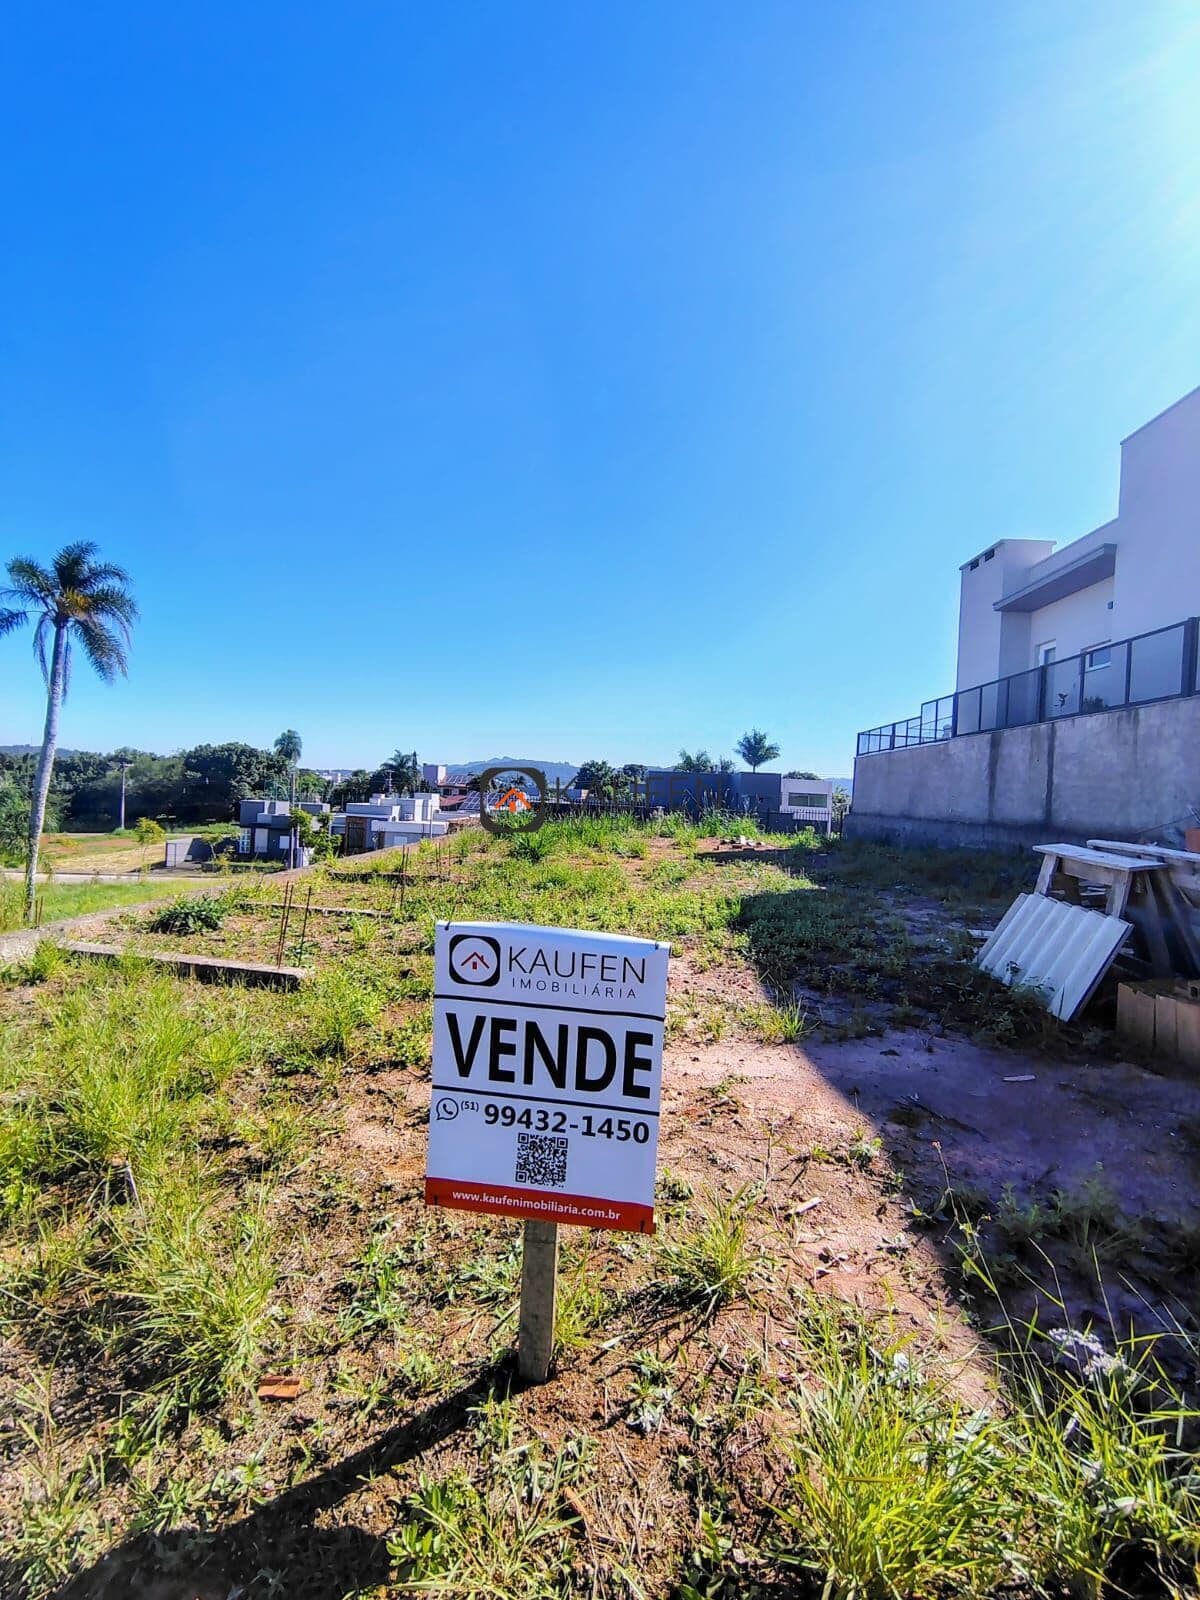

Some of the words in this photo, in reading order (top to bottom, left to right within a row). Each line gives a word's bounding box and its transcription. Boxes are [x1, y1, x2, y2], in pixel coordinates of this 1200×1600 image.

[508, 946, 646, 984] KAUFEN
[512, 977, 636, 999] IMOBILIÁRIA
[445, 1012, 654, 1099] VENDE
[460, 1100, 479, 1113] (51)
[484, 1103, 650, 1144] 99432-1450
[452, 1189, 621, 1221] www.kaufenimobiliaria.com.br
